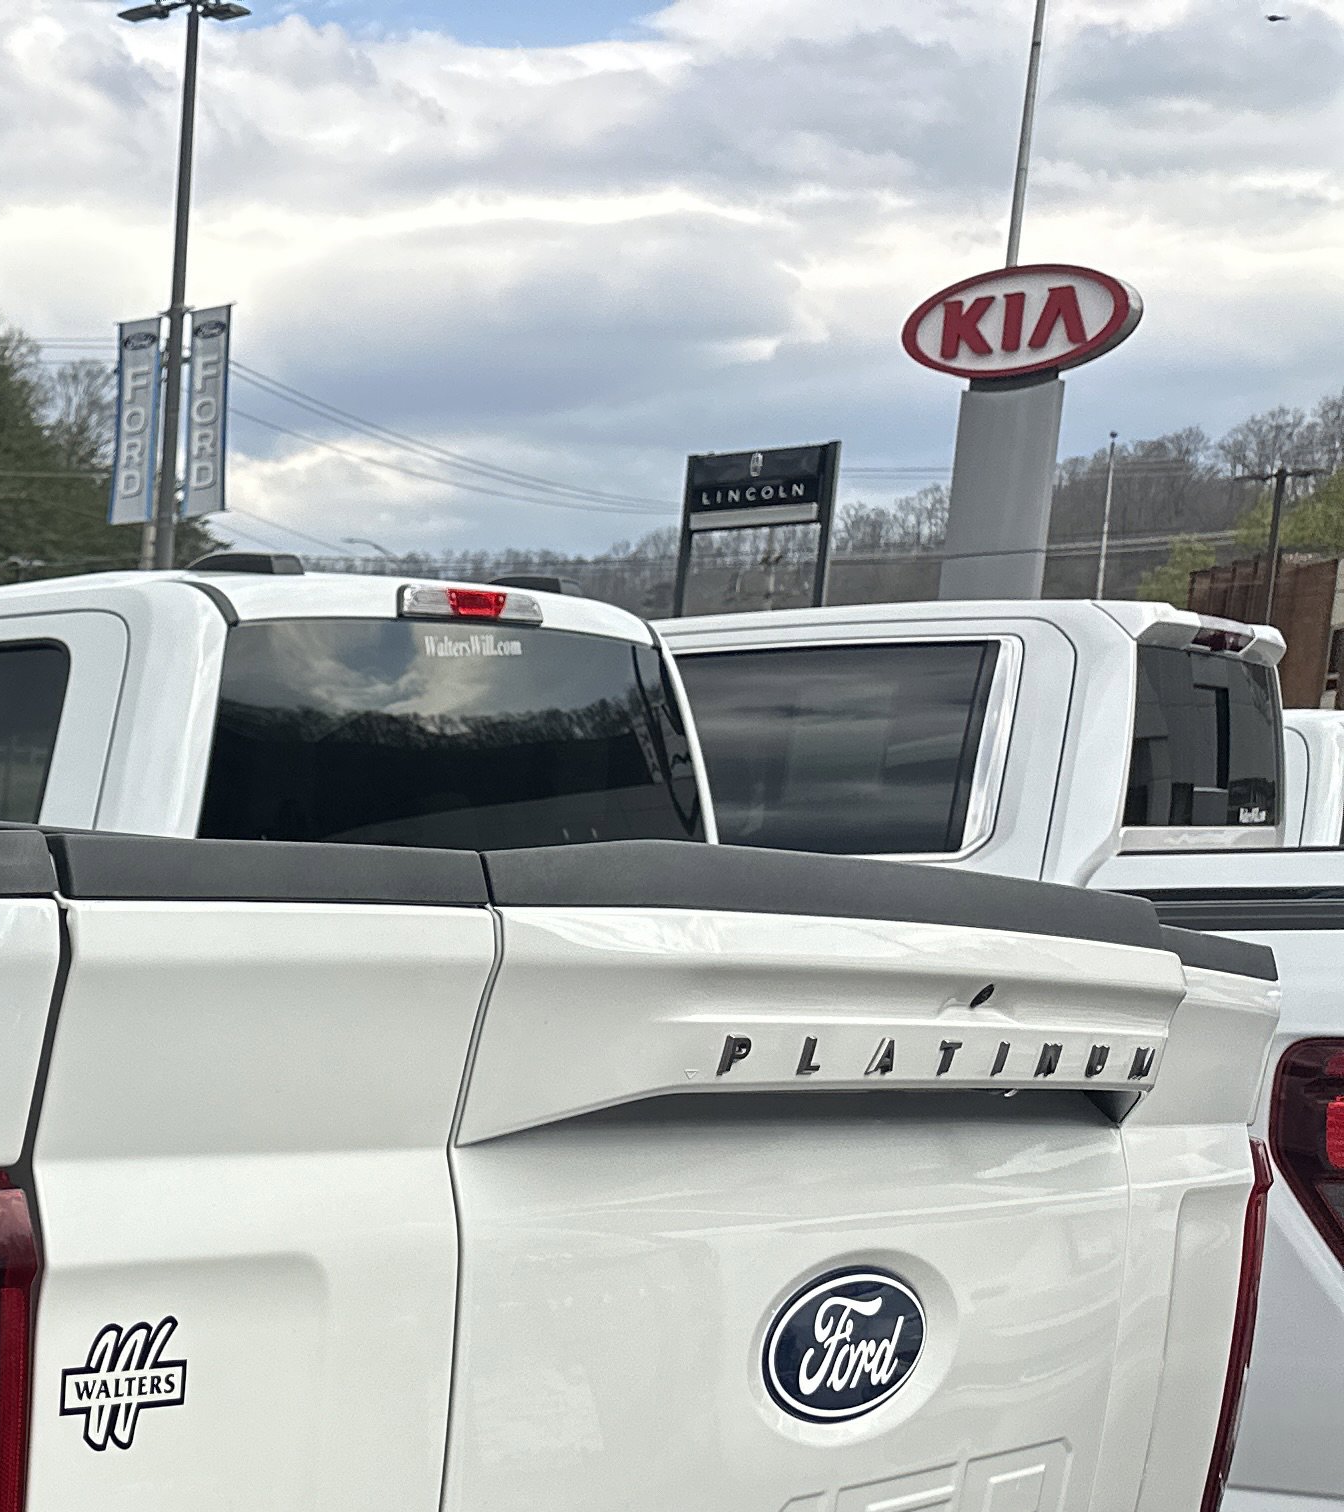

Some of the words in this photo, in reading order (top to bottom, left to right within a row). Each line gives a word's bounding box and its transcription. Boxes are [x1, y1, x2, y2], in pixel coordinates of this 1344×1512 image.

[939, 285, 1088, 359] KIA
[120, 367, 151, 499] FORD
[190, 355, 221, 491] FORD
[701, 483, 805, 506] LINCOLN
[716, 1032, 1157, 1081] PLATINUM
[798, 1296, 905, 1395] Ford
[74, 1373, 176, 1401] WALTERS
